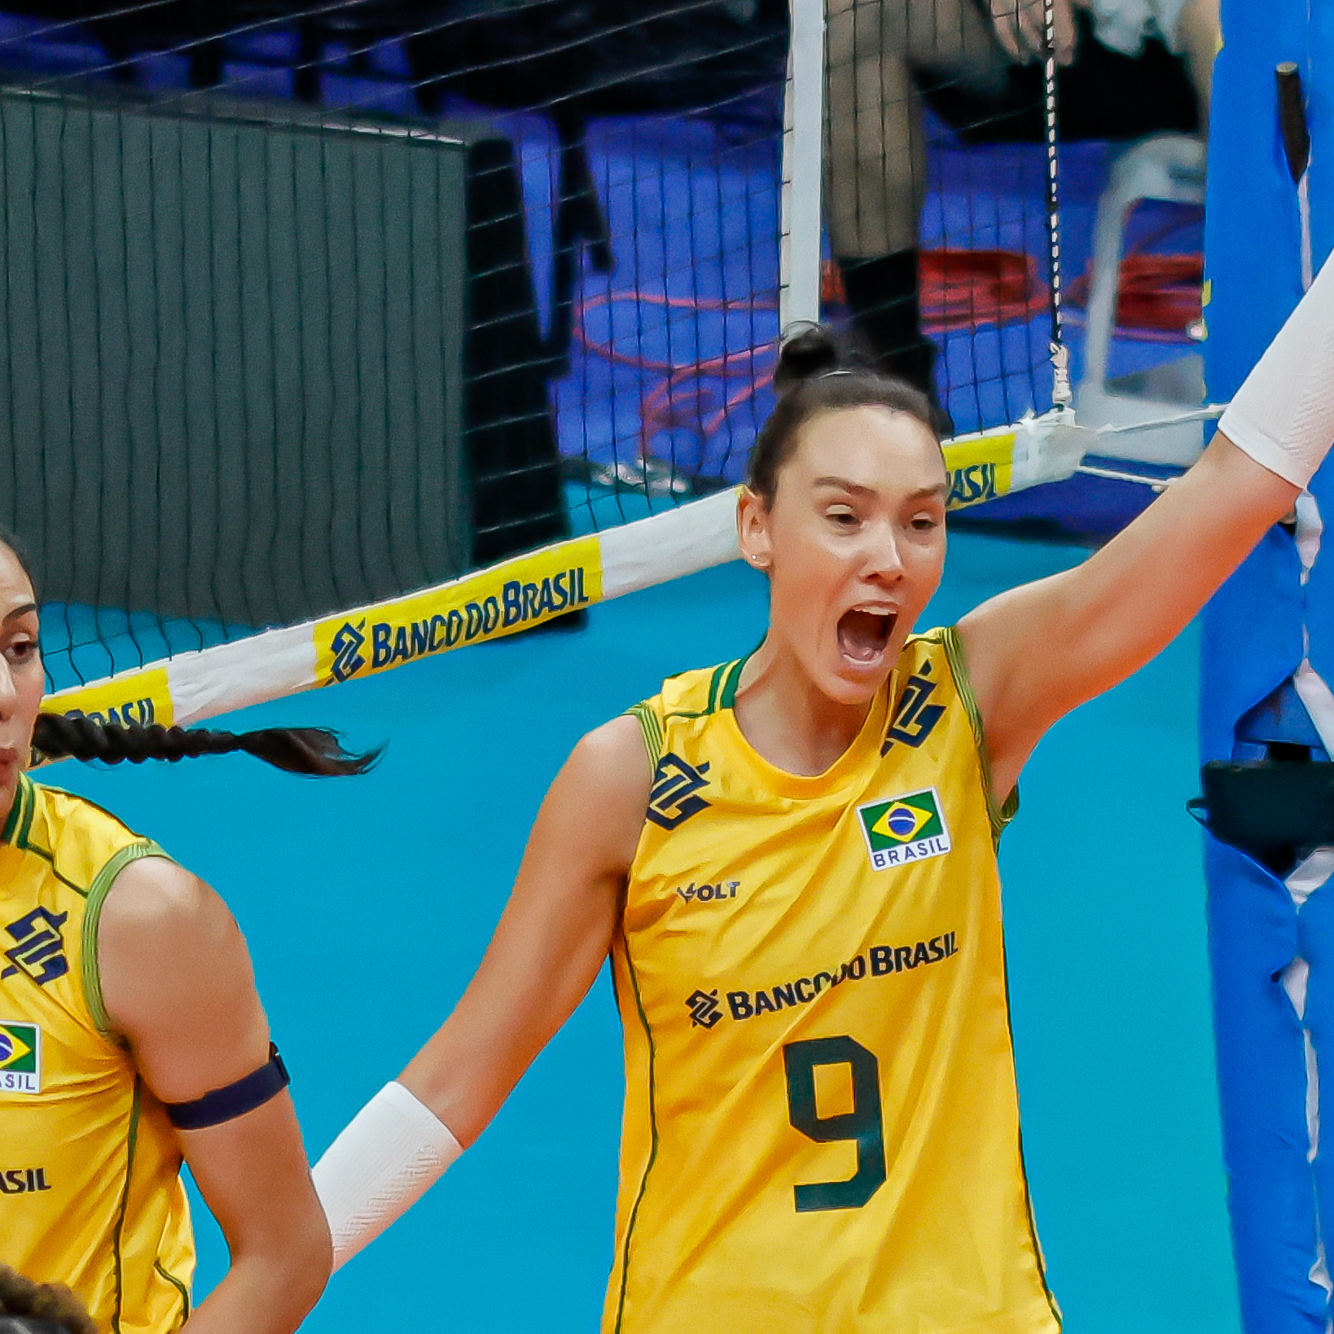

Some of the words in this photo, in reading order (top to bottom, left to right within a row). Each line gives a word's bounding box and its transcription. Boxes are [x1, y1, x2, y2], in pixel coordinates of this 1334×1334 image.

[372, 609, 462, 669] BANCO
[465, 596, 500, 641] DO
[502, 567, 589, 628] BRASIL
[873, 838, 949, 868] BRASIL
[677, 881, 741, 904] VOLT
[869, 931, 959, 977] BRASIL
[783, 1035, 887, 1213] 9
